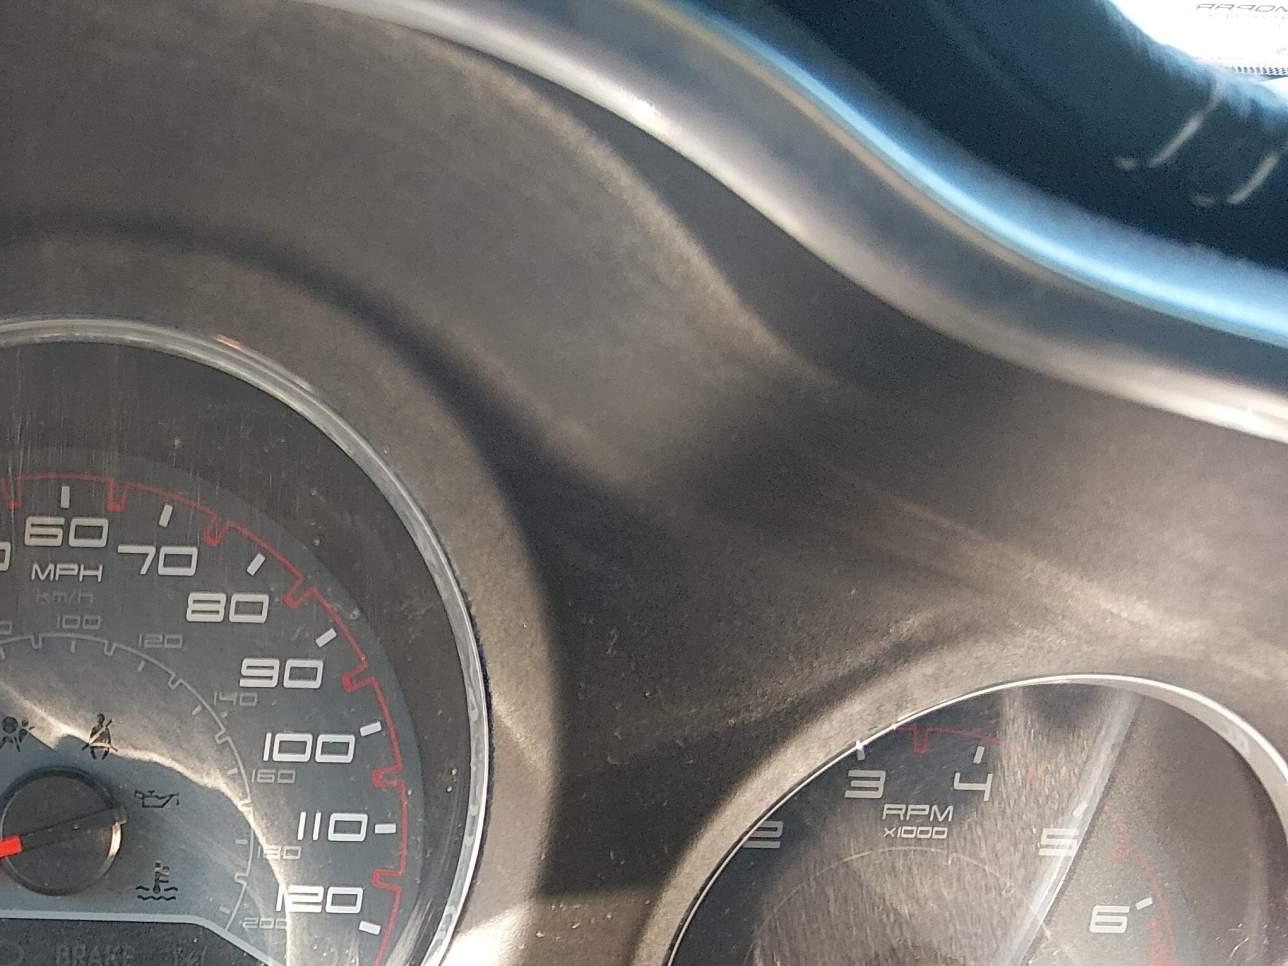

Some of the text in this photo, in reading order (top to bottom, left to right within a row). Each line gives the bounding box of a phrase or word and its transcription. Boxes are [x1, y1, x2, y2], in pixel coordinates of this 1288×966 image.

[23, 515, 109, 547] 60
[31, 562, 104, 583] MPH
[117, 544, 199, 577] 70
[56, 614, 103, 630] 100
[185, 591, 270, 624] 80
[137, 634, 184, 649] 120
[239, 657, 324, 689] 90
[214, 691, 258, 707] 140
[262, 732, 356, 763] 100
[252, 768, 296, 784] 160
[844, 769, 887, 799] 3
[952, 770, 993, 802] 4
[297, 810, 369, 842] 110
[882, 803, 955, 823] RPM
[743, 820, 785, 849] 2
[1037, 827, 1080, 857] 5
[275, 881, 364, 914] 120
[1089, 904, 1131, 934] 6
